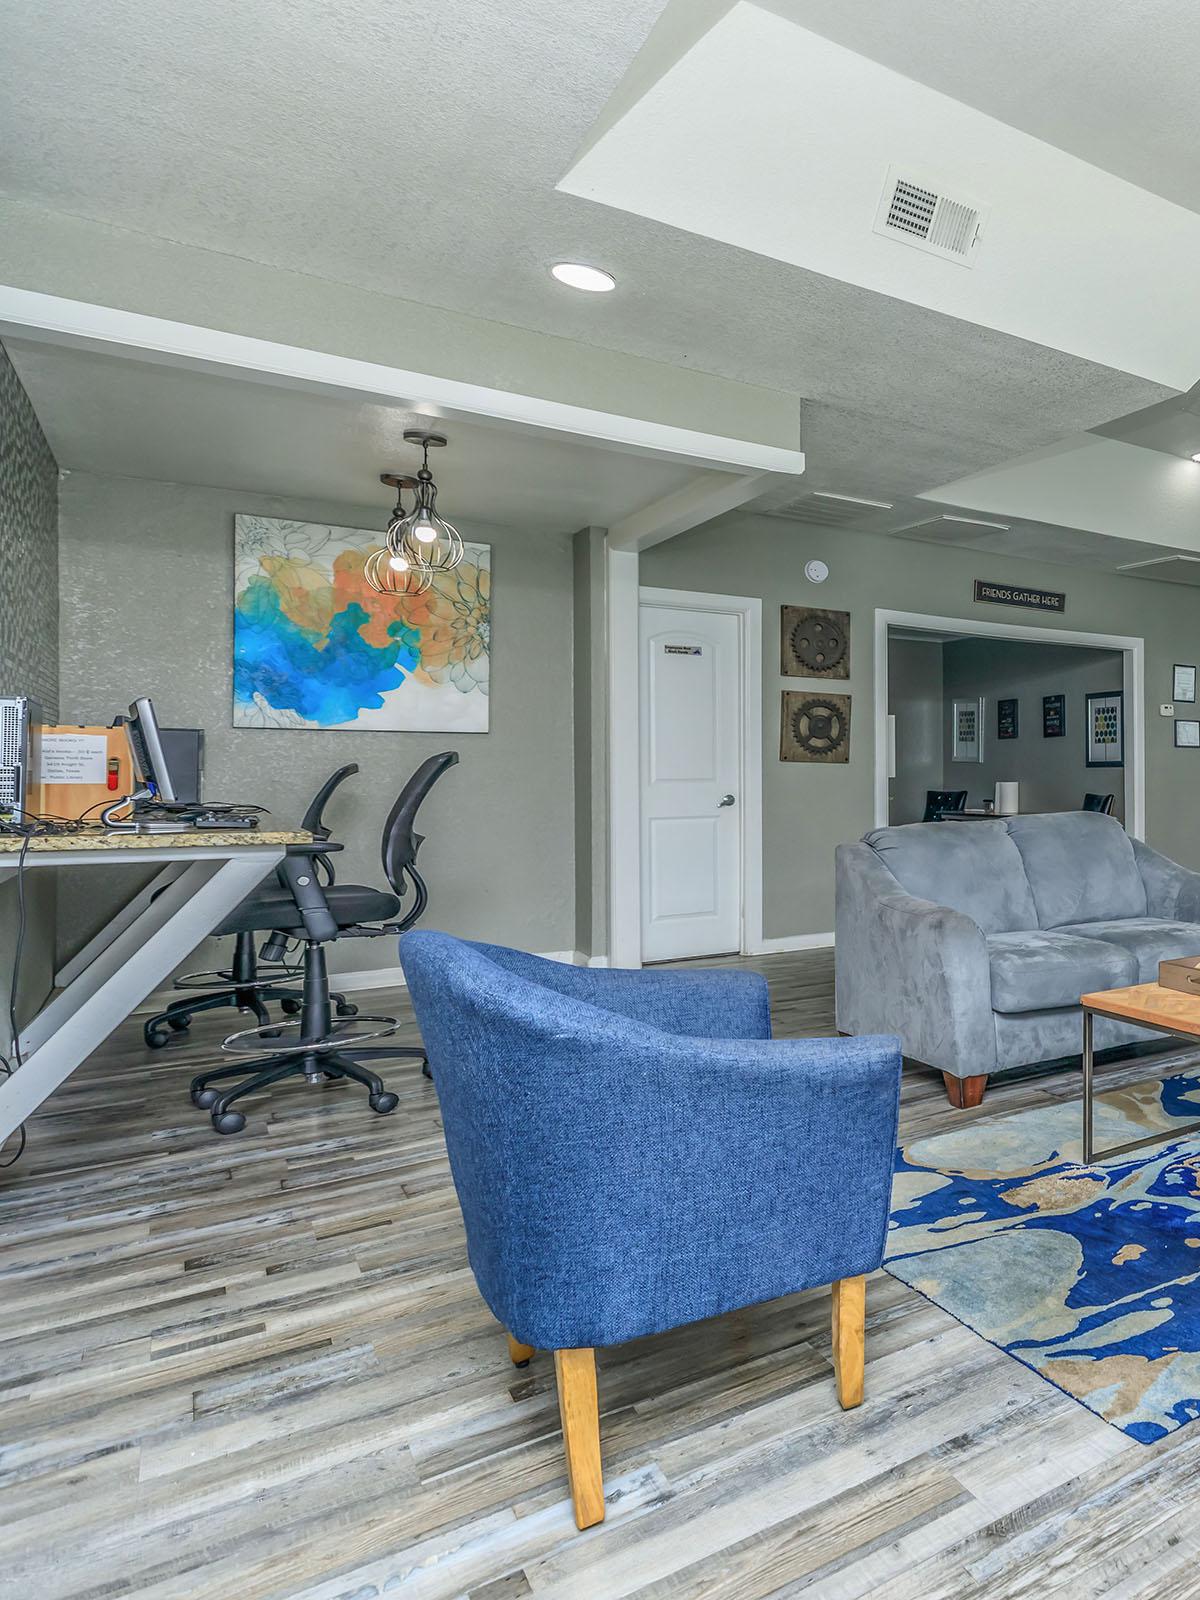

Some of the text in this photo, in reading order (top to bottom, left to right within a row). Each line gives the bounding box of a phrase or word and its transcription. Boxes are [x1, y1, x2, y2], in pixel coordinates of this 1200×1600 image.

[982, 587, 1060, 606] FRIENDS GATHER HERE
